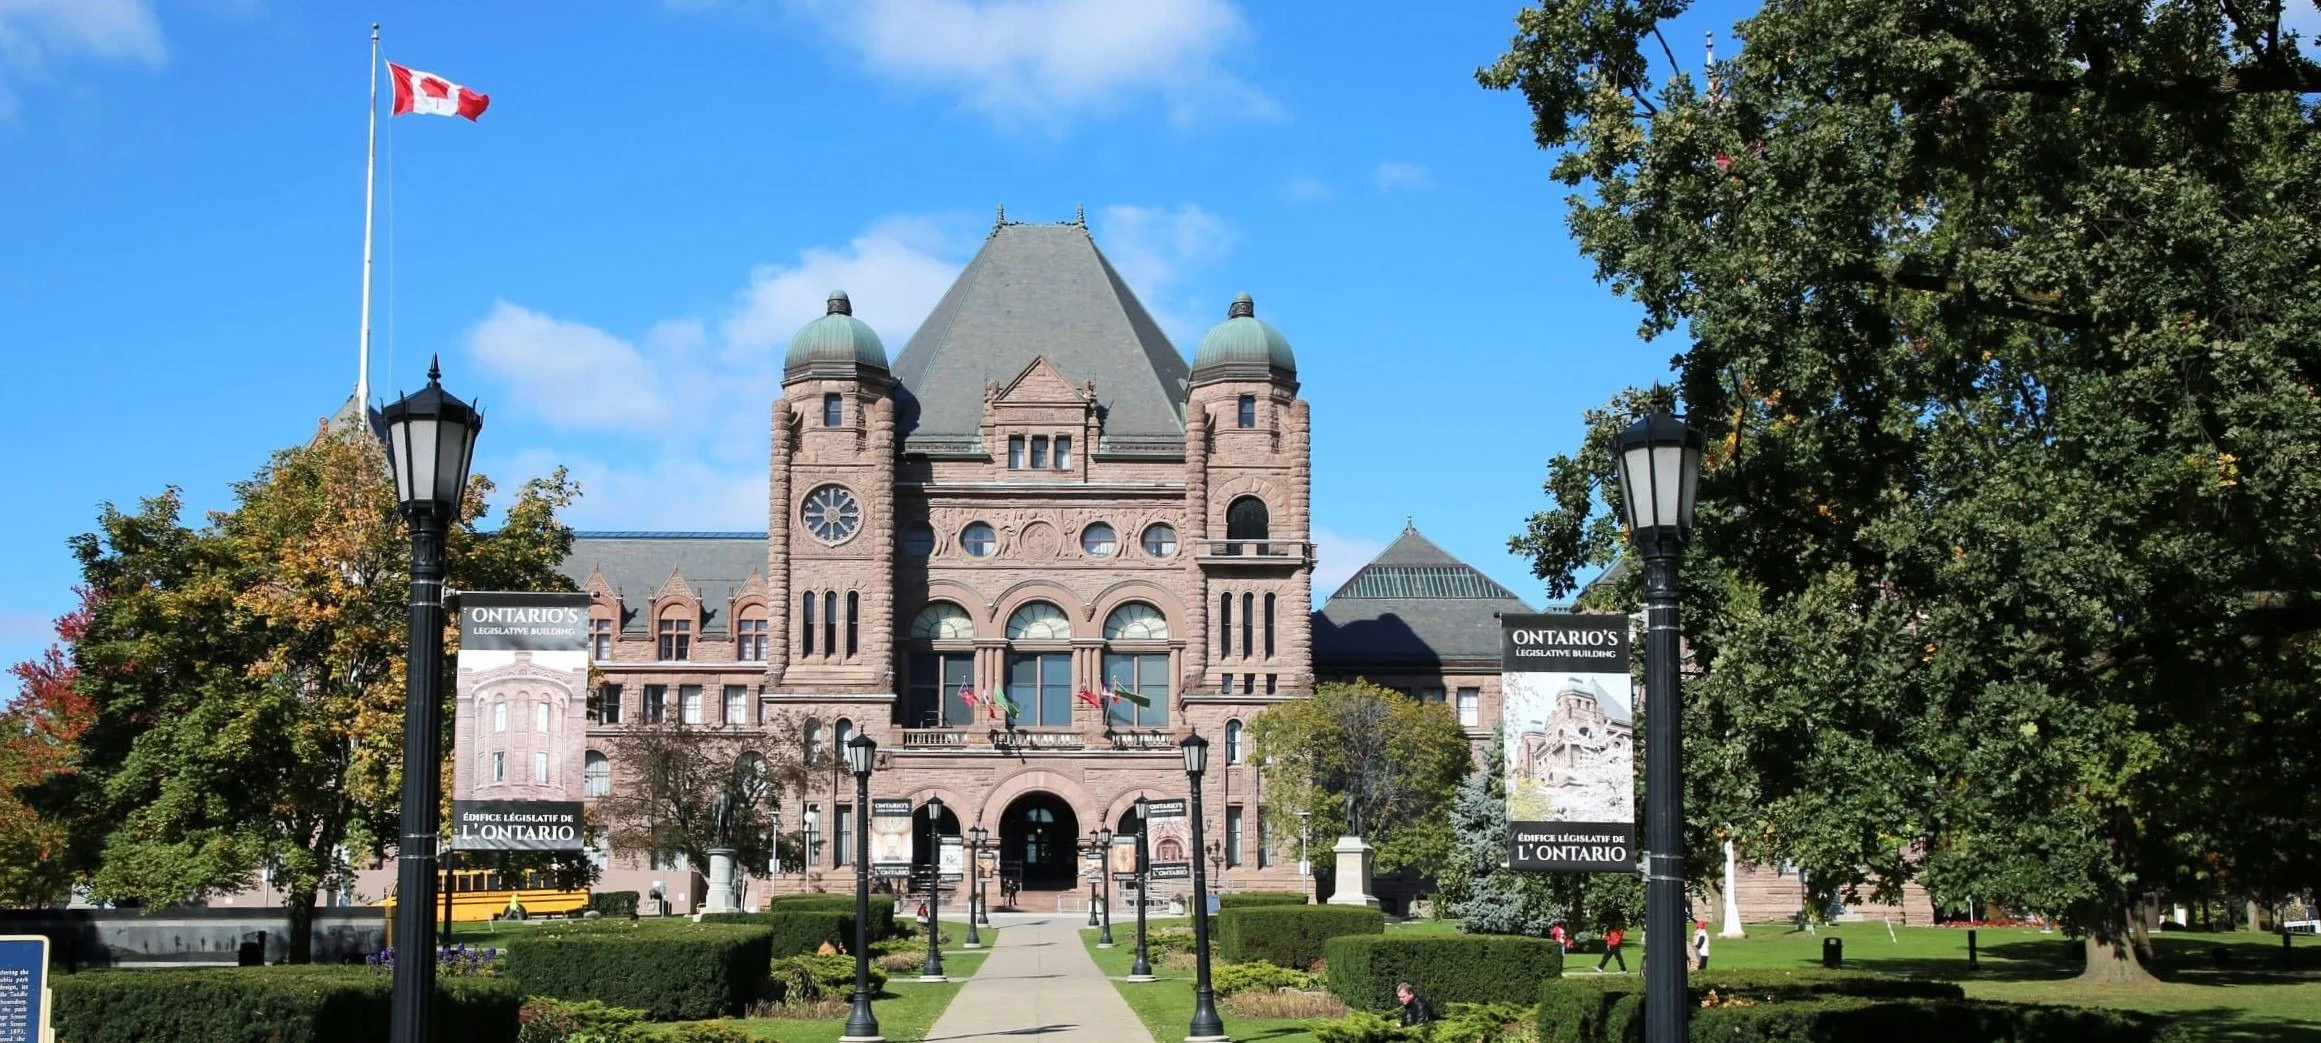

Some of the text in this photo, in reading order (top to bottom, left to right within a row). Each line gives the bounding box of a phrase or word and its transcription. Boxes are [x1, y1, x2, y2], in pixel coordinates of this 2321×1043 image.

[472, 607, 579, 623] ONTARIO'S
[473, 627, 575, 636] LEGISLATIVE BUILDING
[1512, 629, 1619, 646] ONTARIO'S
[1515, 649, 1616, 658] LEGISLATIVE BUILDING
[462, 811, 574, 823] ÉDIFICE LÉGISLATIF DE
[462, 823, 575, 841] L'ONTARIO
[1517, 832, 1626, 843] ÉDIFICE LÉGISLATIF DE
[1517, 843, 1627, 862] L'ONTARIO
